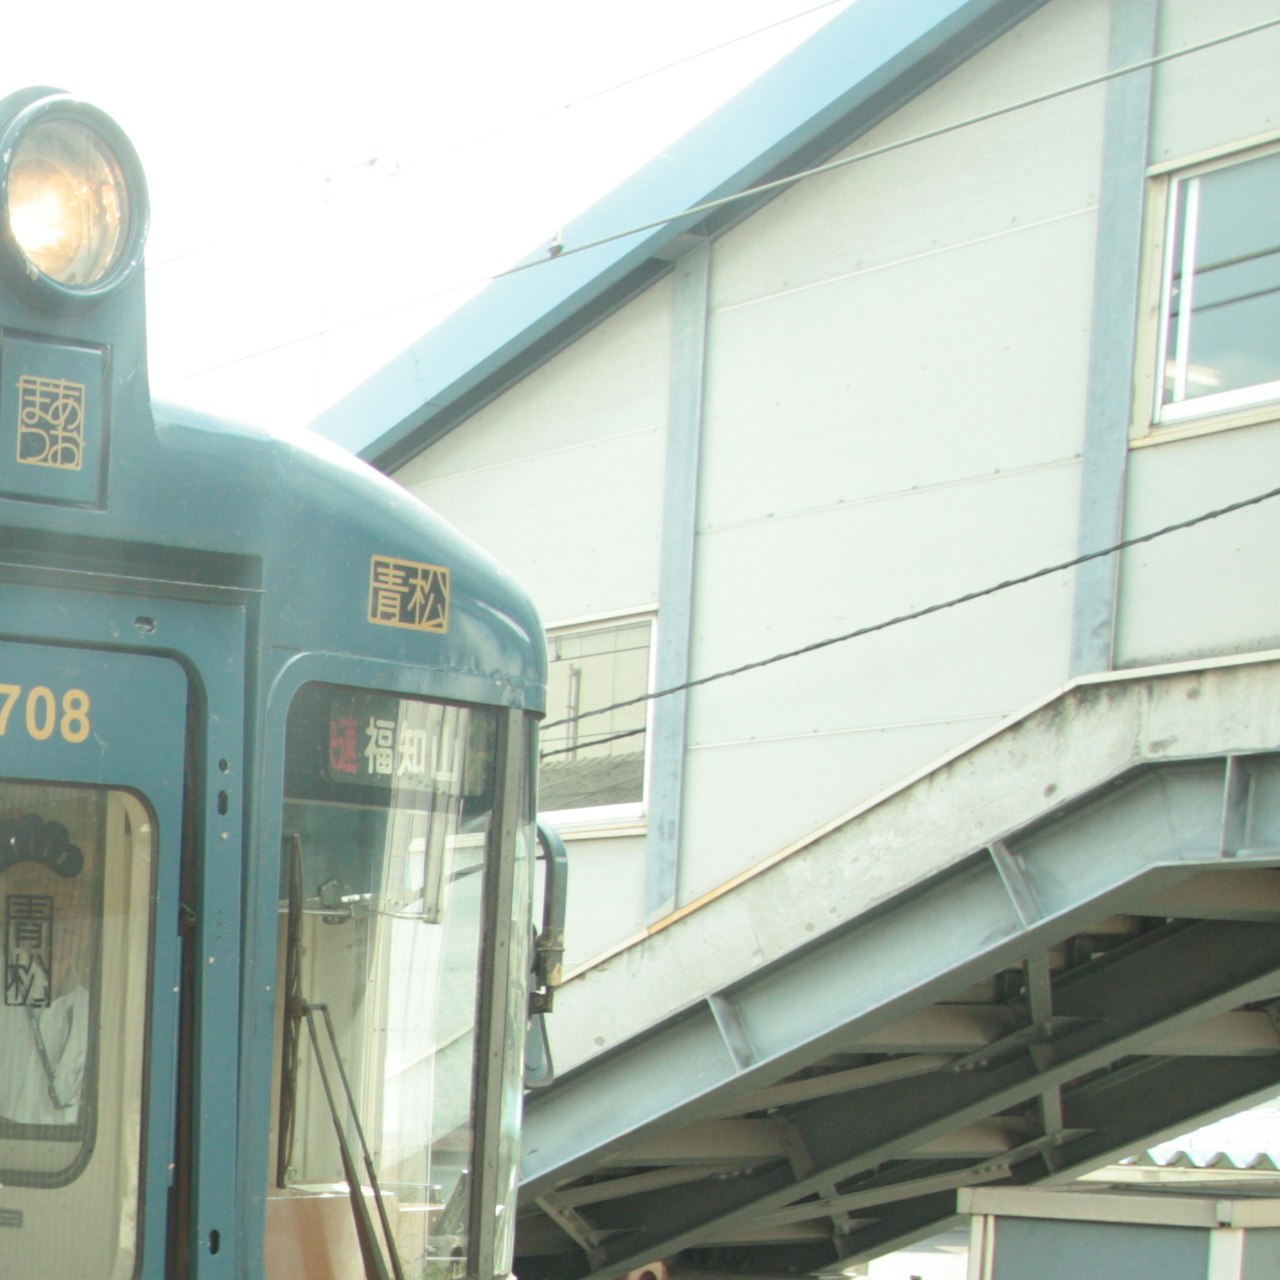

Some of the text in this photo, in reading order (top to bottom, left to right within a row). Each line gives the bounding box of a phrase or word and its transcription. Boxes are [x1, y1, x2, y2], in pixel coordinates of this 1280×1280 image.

[368, 555, 450, 634] 青松
[364, 716, 458, 782] 福知山
